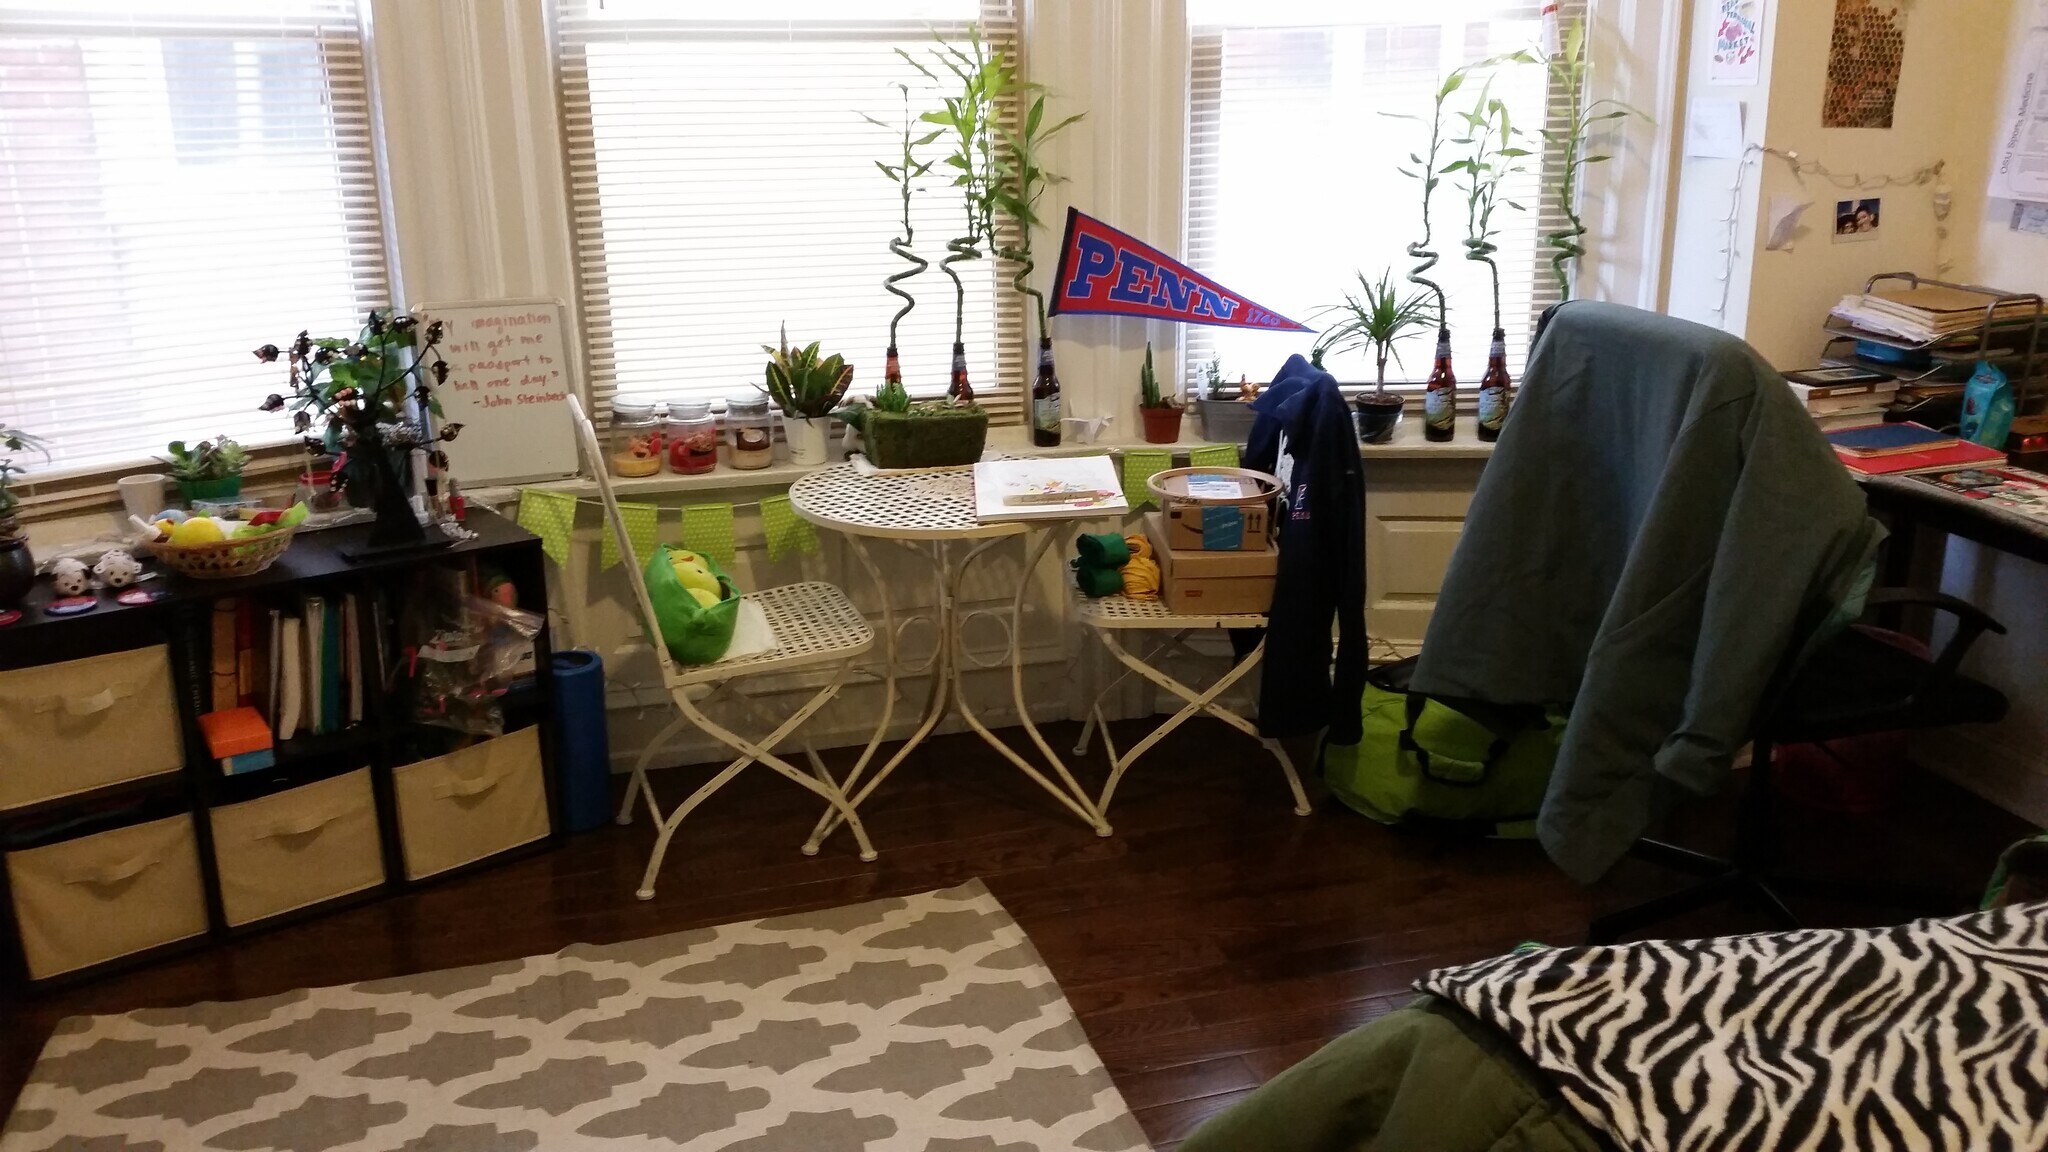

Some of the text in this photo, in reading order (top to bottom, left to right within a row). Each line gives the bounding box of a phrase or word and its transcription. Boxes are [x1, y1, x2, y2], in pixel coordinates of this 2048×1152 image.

[1717, 36, 1749, 52] MARKET
[2000, 72, 2035, 175] OSU Sports Medicine
[1066, 231, 1281, 327] PENN 1740
[471, 313, 551, 334] imagination
[487, 335, 513, 357] get
[520, 333, 543, 344] me
[539, 354, 553, 364] to
[487, 377, 511, 388] one
